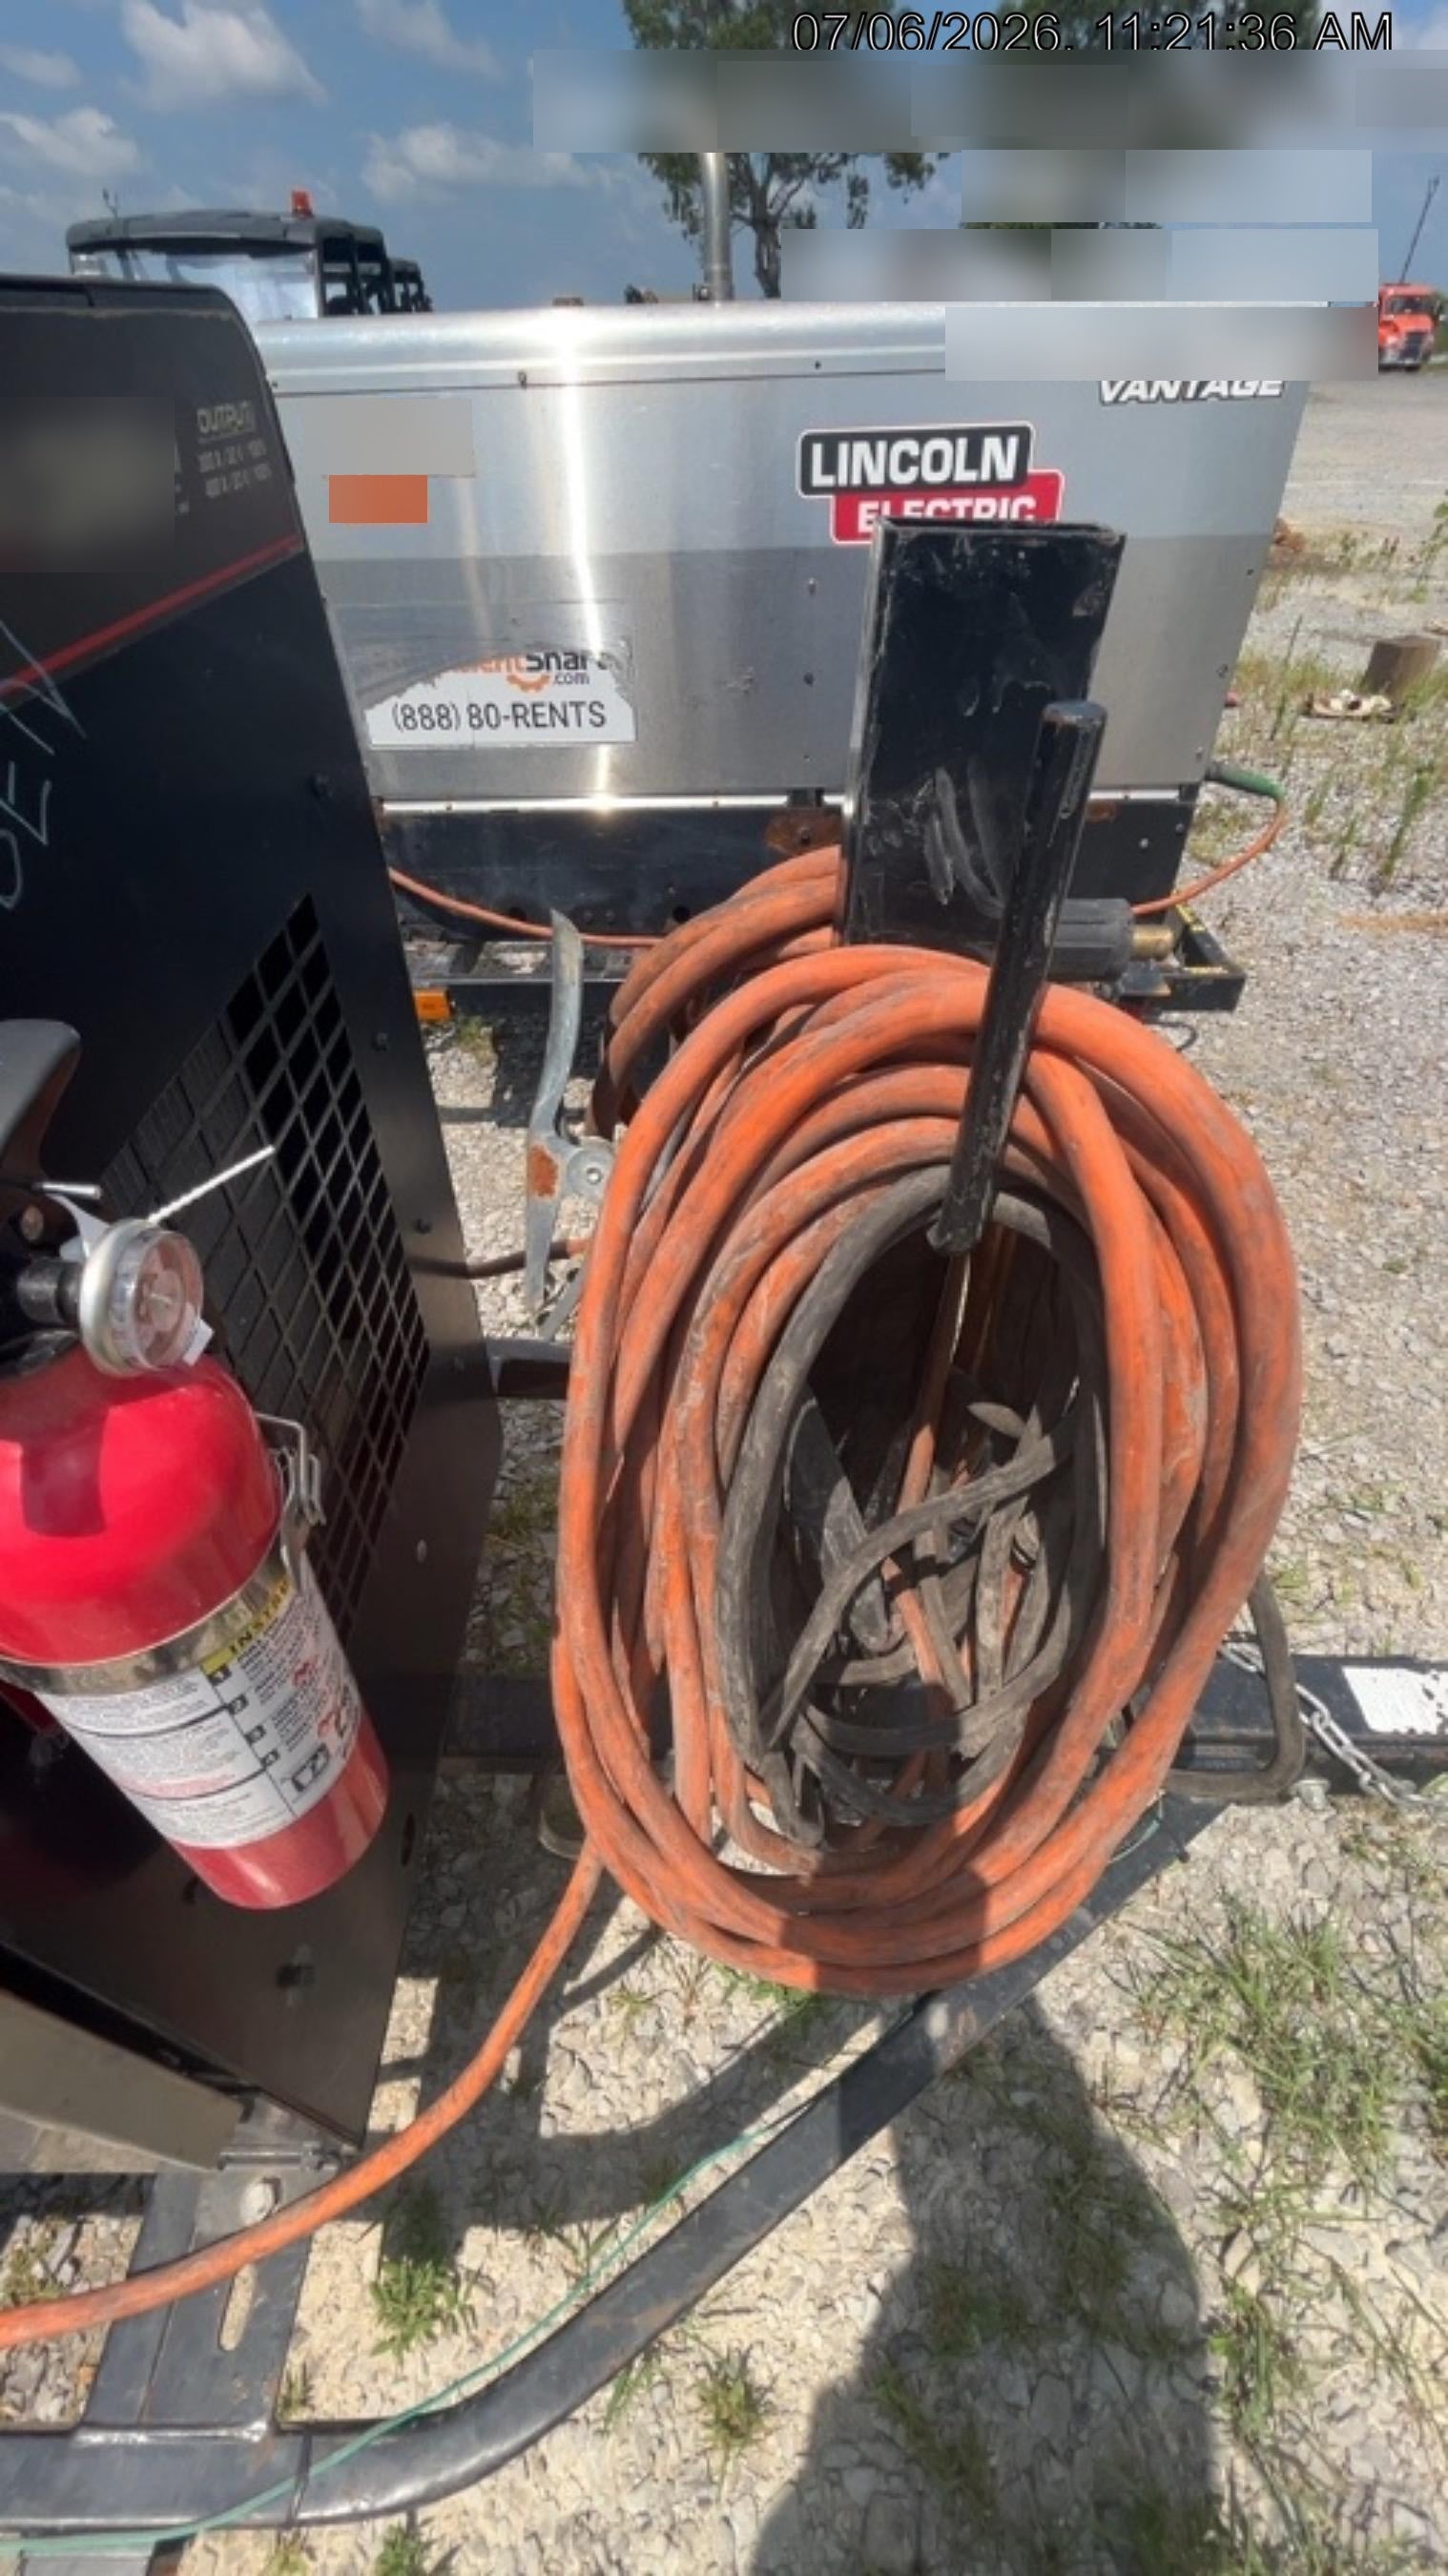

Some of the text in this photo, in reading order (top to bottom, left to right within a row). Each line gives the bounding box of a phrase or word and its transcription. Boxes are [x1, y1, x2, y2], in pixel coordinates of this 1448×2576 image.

[811, 434, 1020, 488] LINCOLN
[858, 495, 1037, 533] ELECTRIC
[391, 699, 608, 733] (888) 80-RENTS
